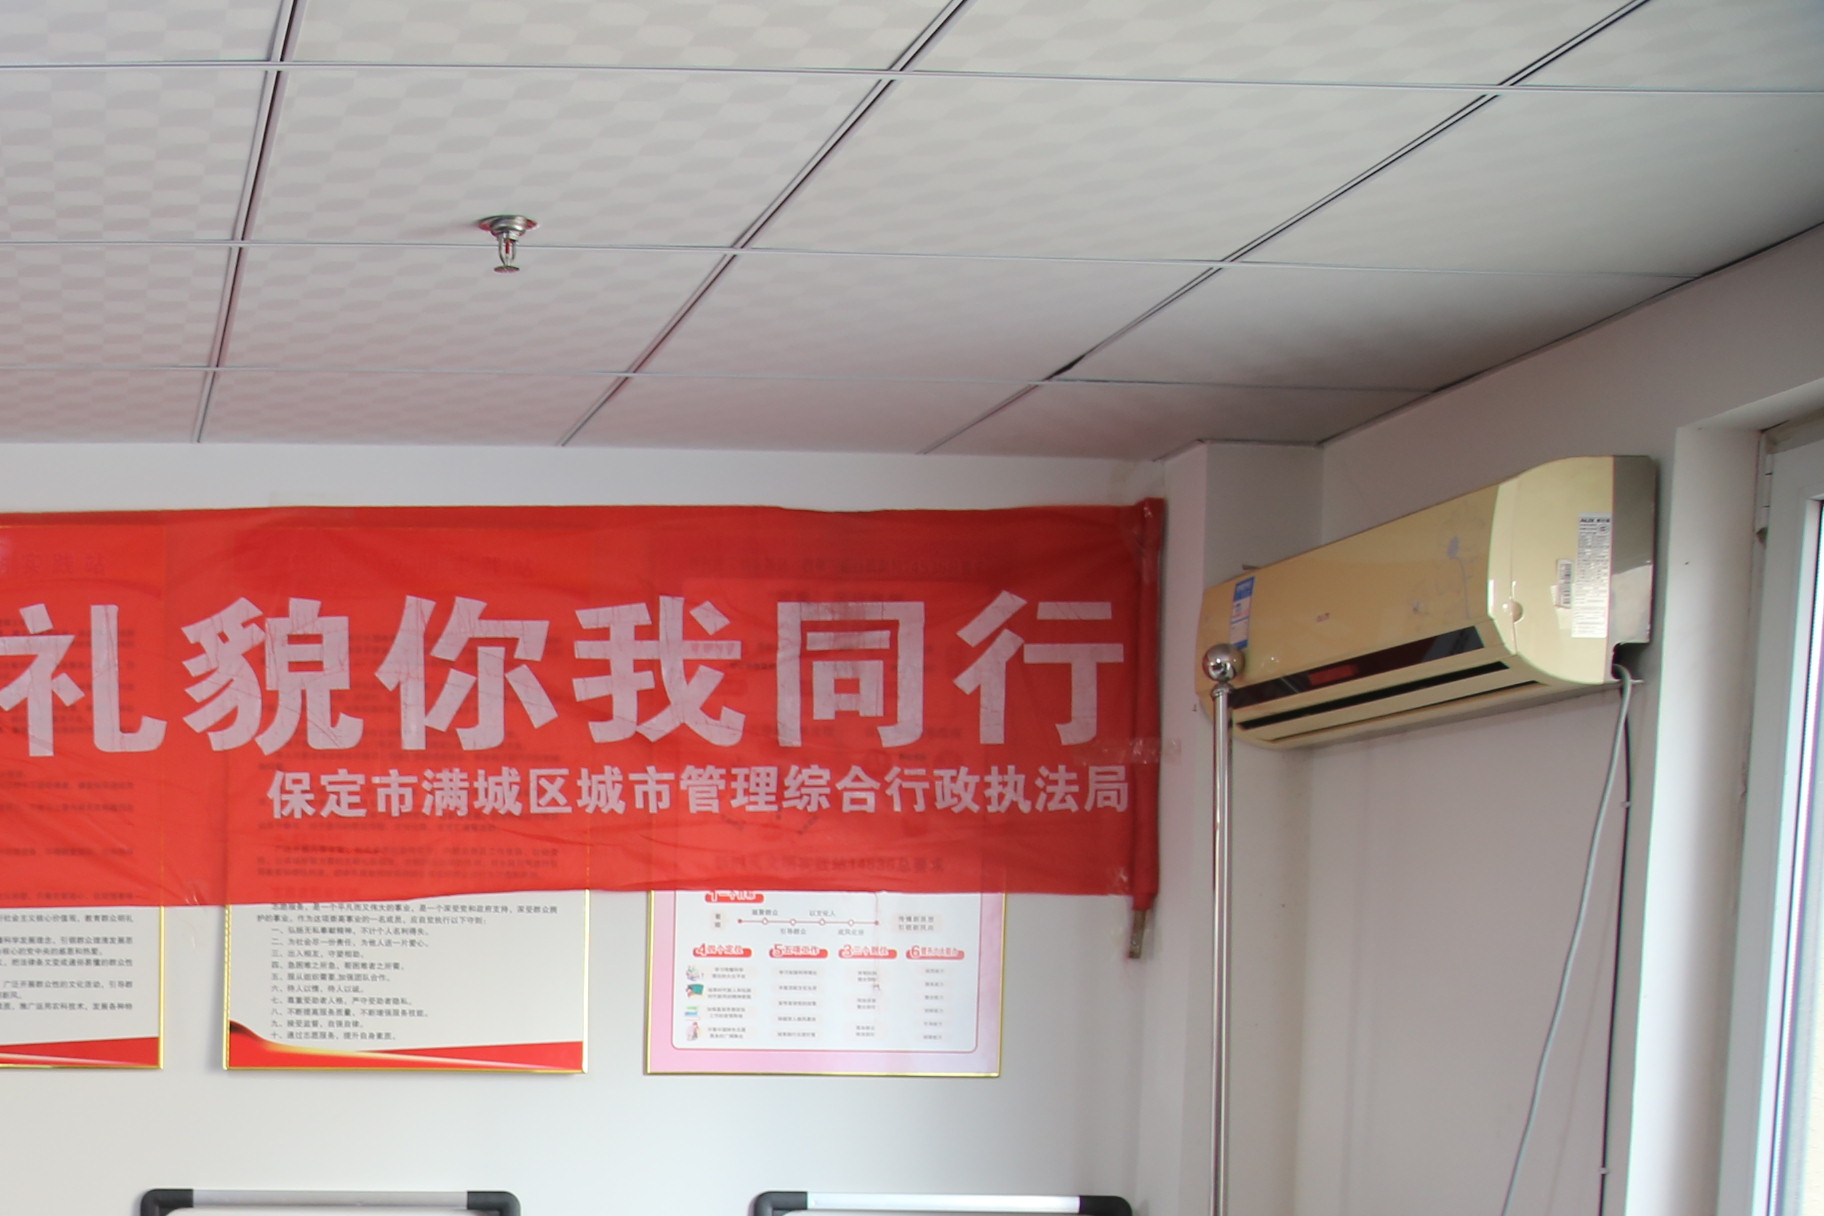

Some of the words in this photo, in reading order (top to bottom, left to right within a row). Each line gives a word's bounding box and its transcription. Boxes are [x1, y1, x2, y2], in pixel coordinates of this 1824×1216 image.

[267, 764, 1130, 819] 保定市满城区城市管理综合行政执法局
